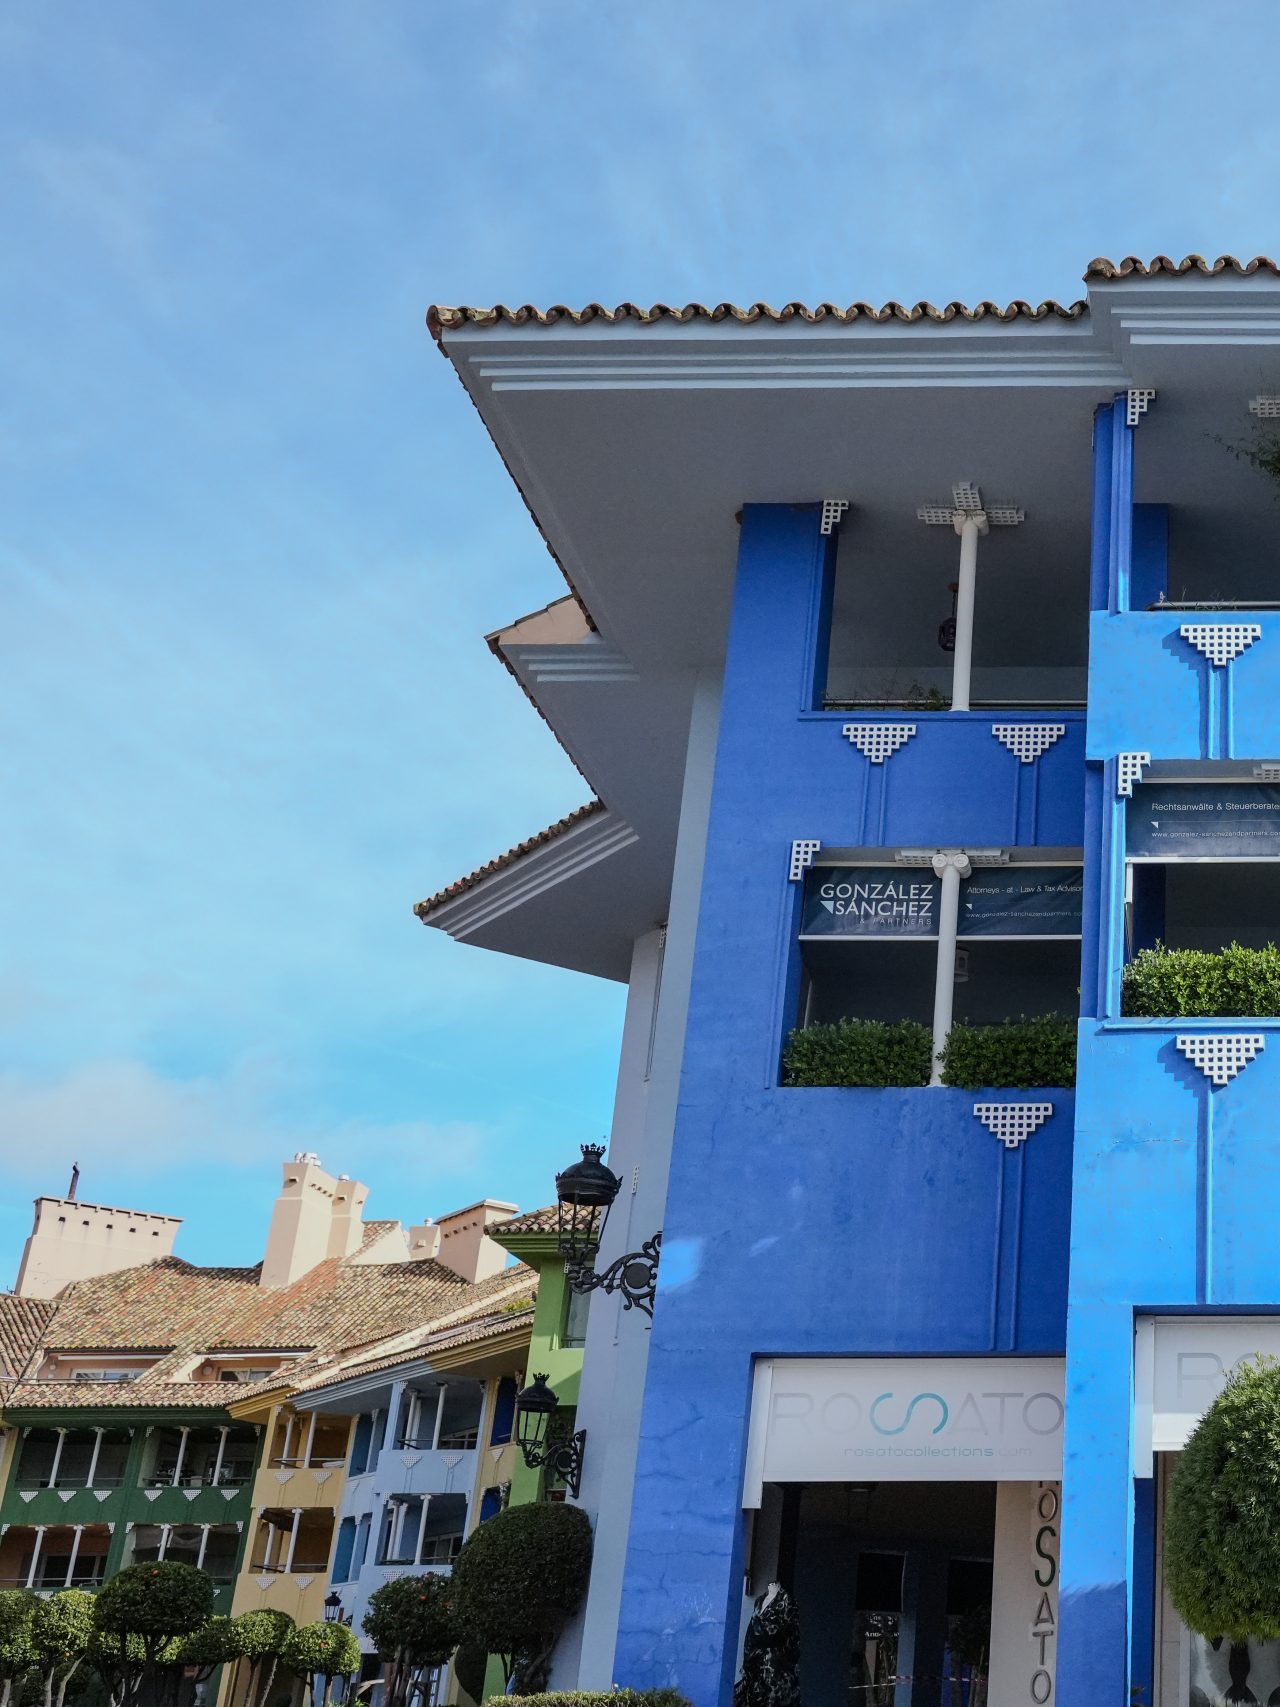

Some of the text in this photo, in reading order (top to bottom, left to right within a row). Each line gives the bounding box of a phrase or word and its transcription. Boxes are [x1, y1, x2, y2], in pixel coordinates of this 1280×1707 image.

[1151, 802, 1214, 811] Rechtsanwälte
[1216, 803, 1223, 811] &
[820, 880, 934, 899] GONZÁLEZ
[966, 886, 1000, 894] Attorneys
[1020, 885, 1035, 893] Law
[1056, 884, 1083, 892] Advisor
[835, 897, 933, 916] SÁNCHEZ
[873, 917, 932, 925] PARTNERS
[768, 1391, 1064, 1437] ROSATO
[1030, 1481, 1059, 1705] OSATO
